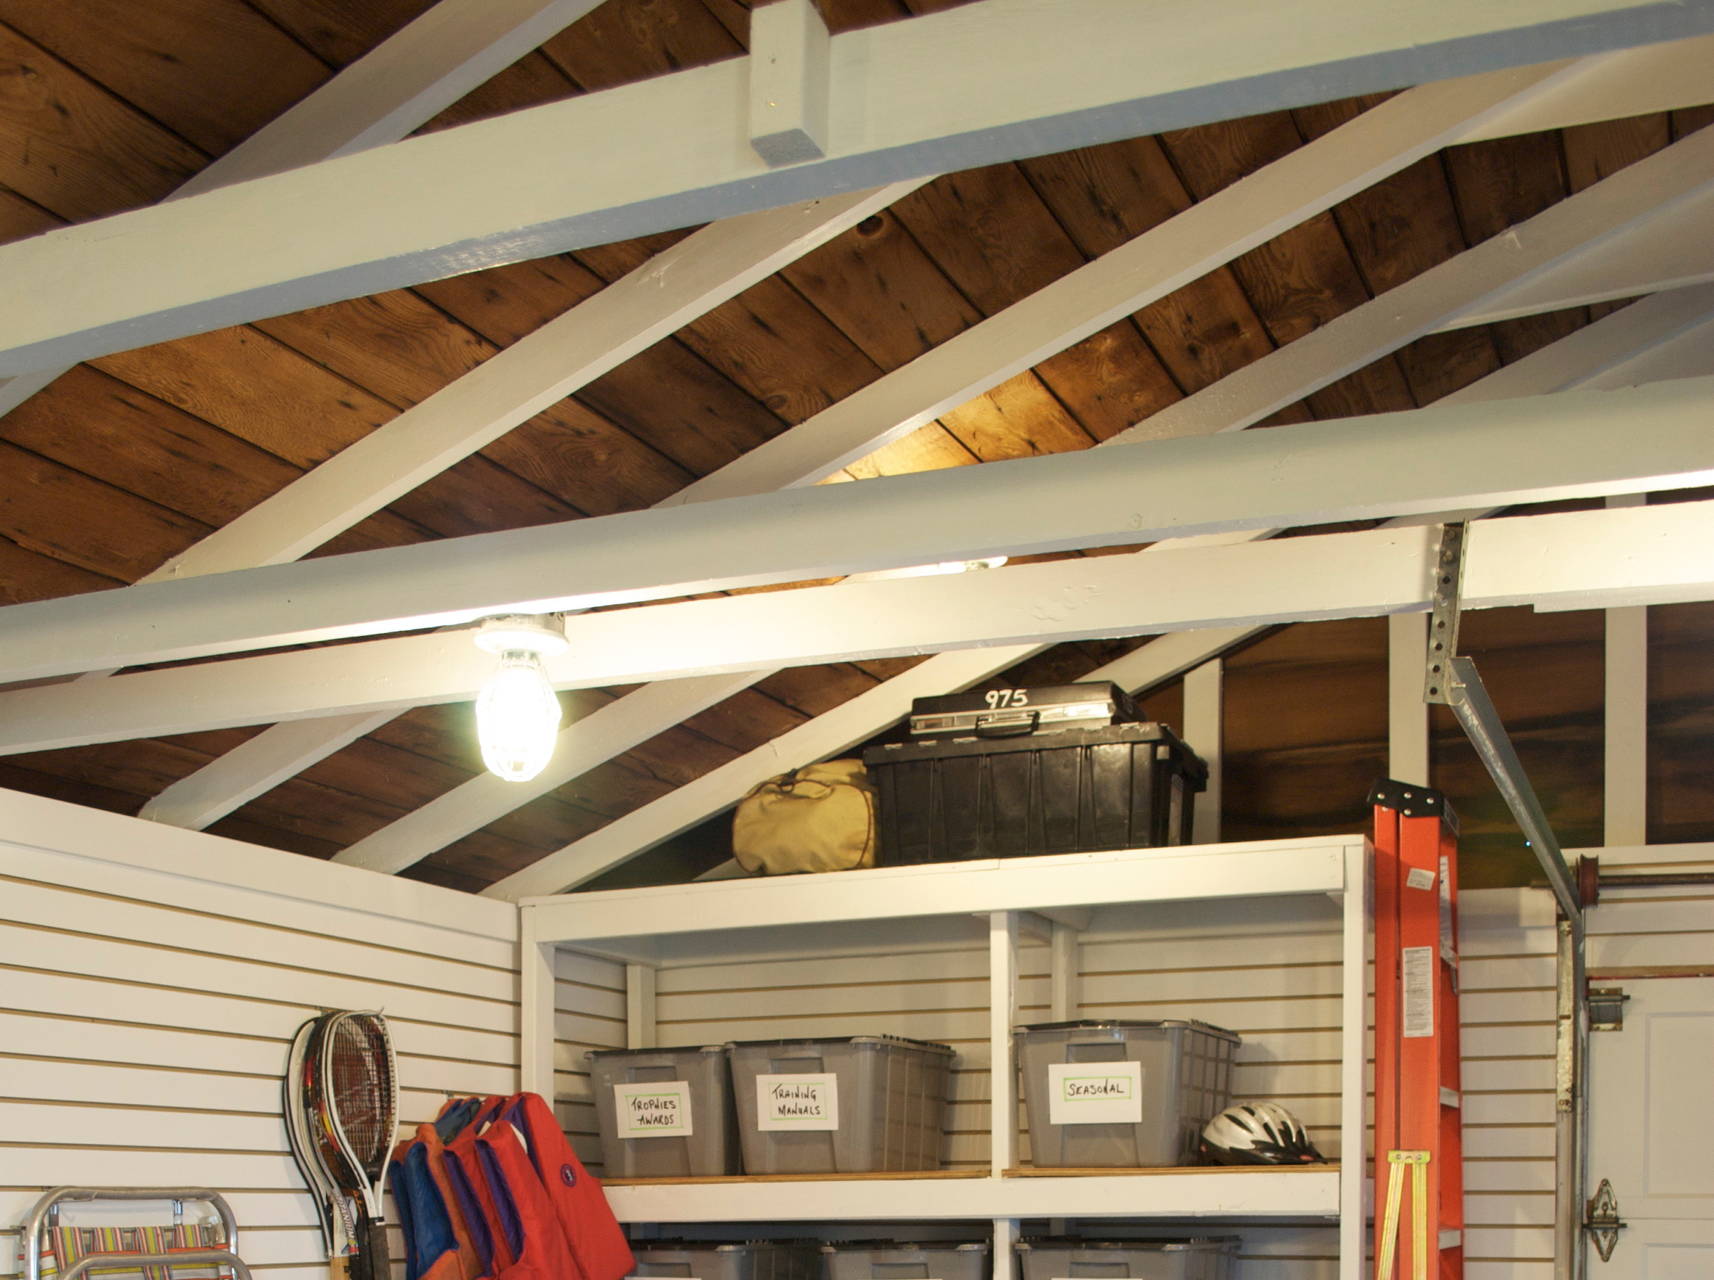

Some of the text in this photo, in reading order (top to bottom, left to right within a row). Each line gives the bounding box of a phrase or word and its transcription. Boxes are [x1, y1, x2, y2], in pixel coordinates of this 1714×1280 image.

[985, 689, 1028, 709] 975
[772, 1083, 817, 1100] TRAINING
[1067, 1079, 1124, 1097] SEASONAL
[631, 1097, 676, 1111] TROPHIES
[778, 1102, 821, 1116] MANUALS
[637, 1115, 674, 1126] AWARDS
